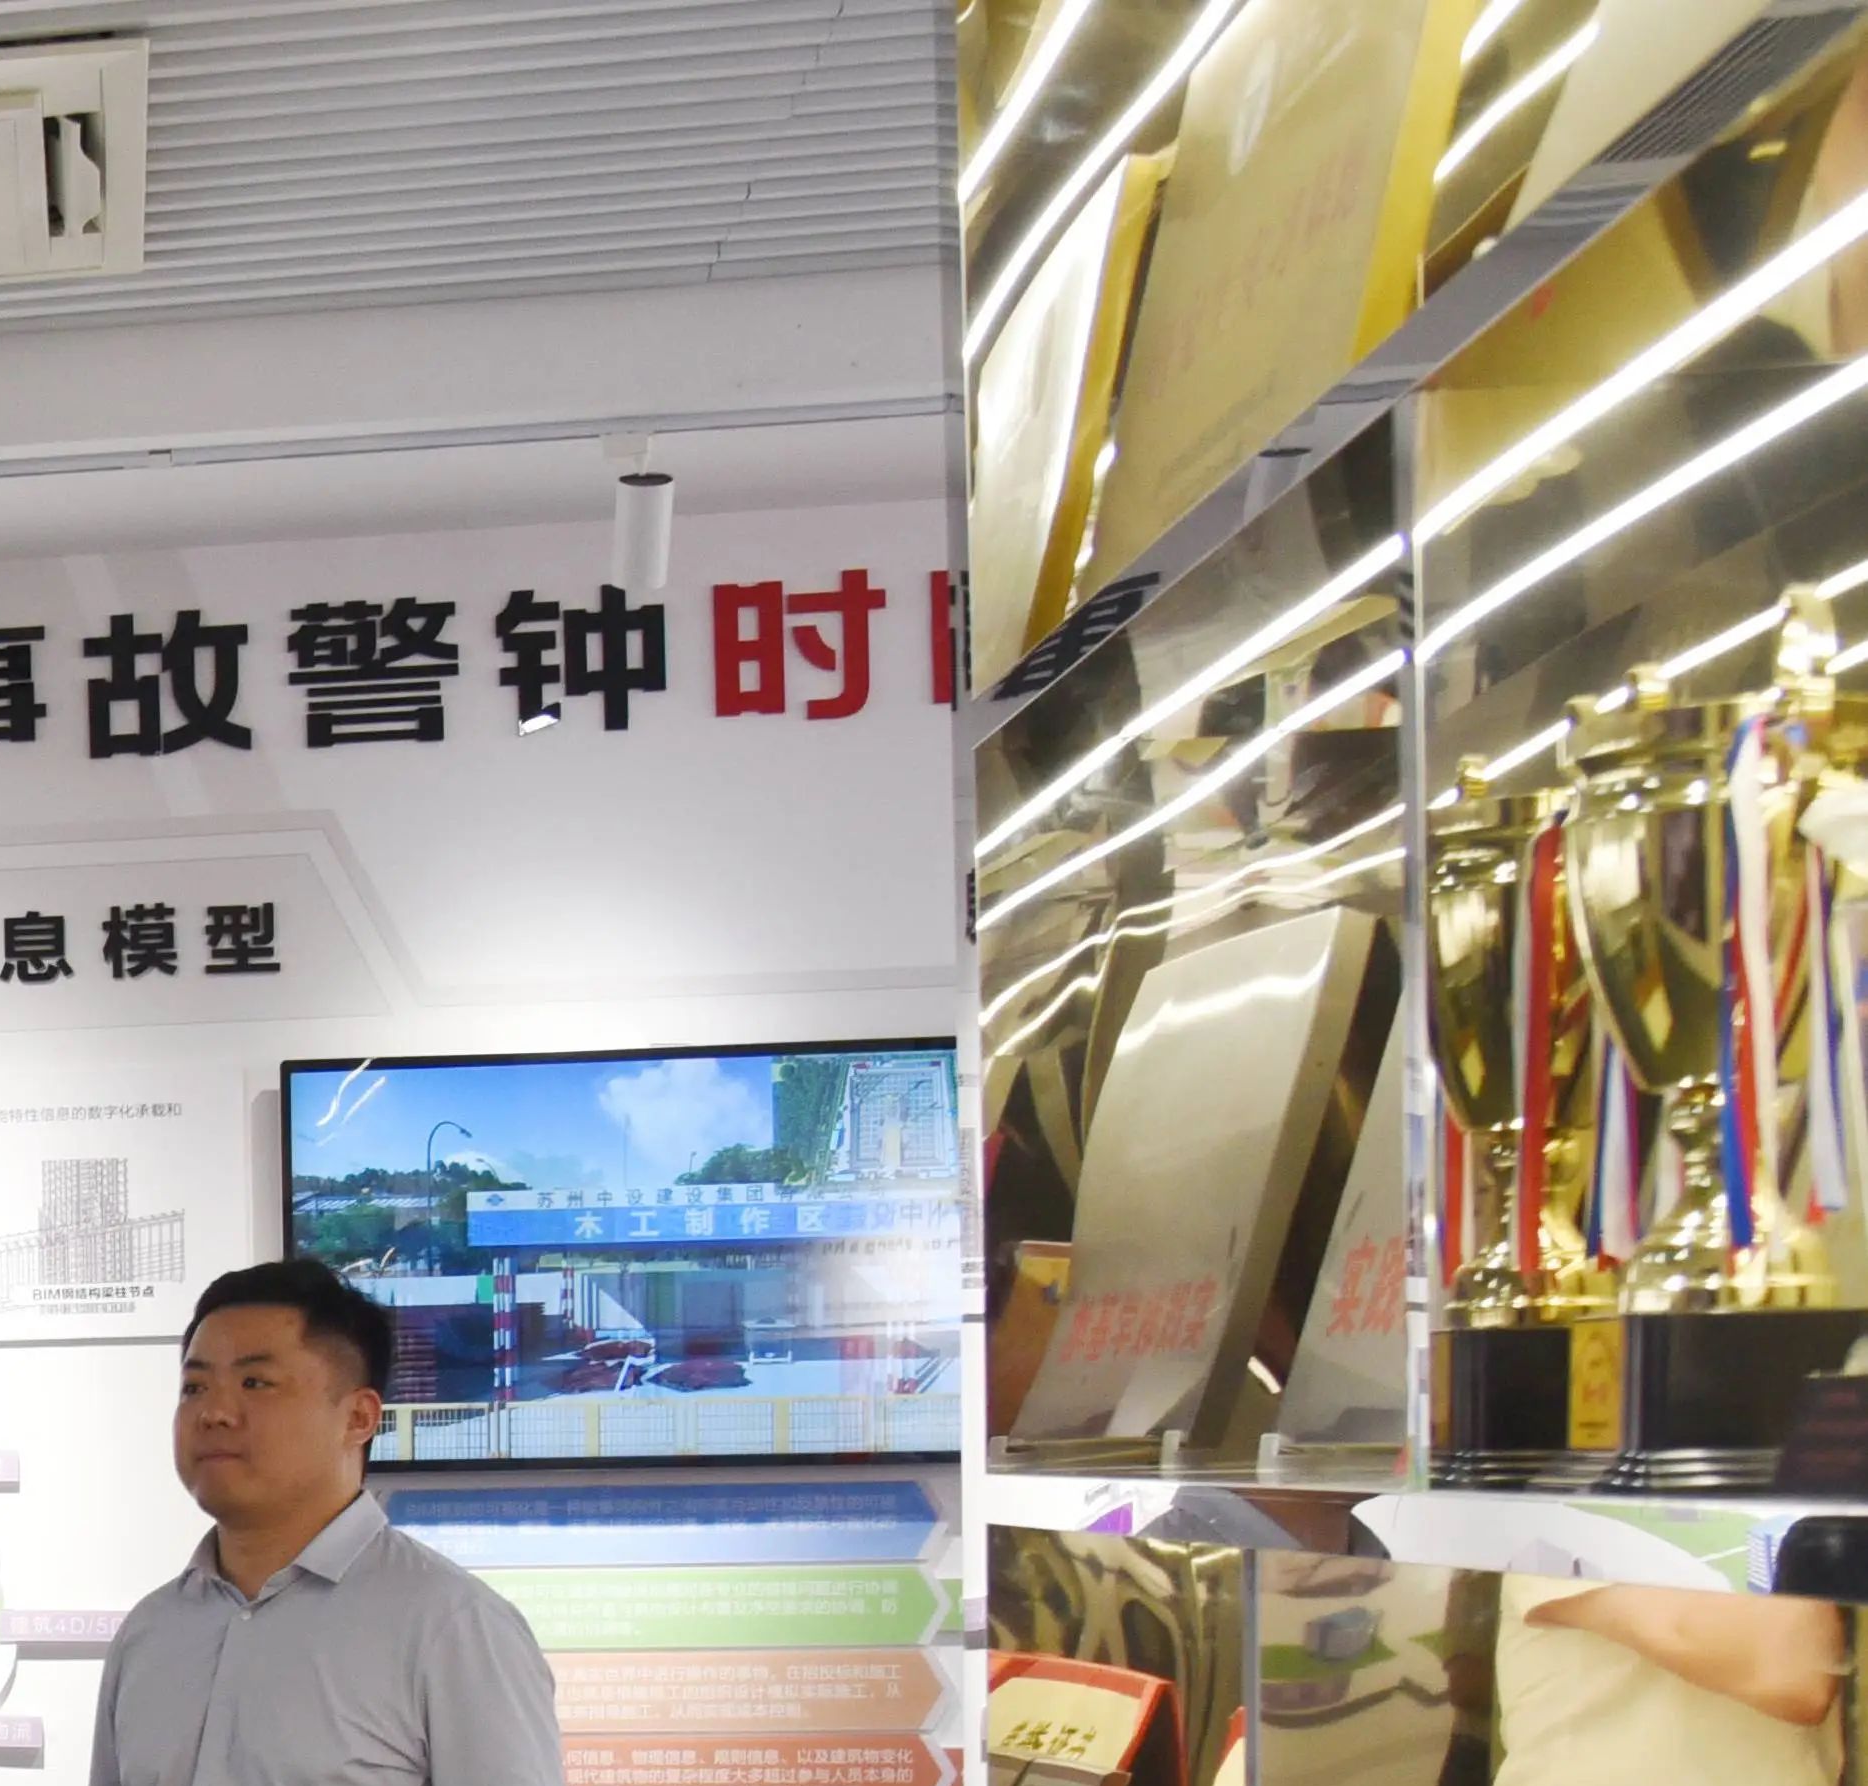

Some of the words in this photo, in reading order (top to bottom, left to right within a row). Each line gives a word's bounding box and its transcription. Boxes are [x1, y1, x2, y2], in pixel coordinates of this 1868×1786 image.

[573, 1205, 827, 1239] 木工制作区
[562, 1747, 914, 1767] 何信息、物理信息、规则信息、以及建筑物变化
